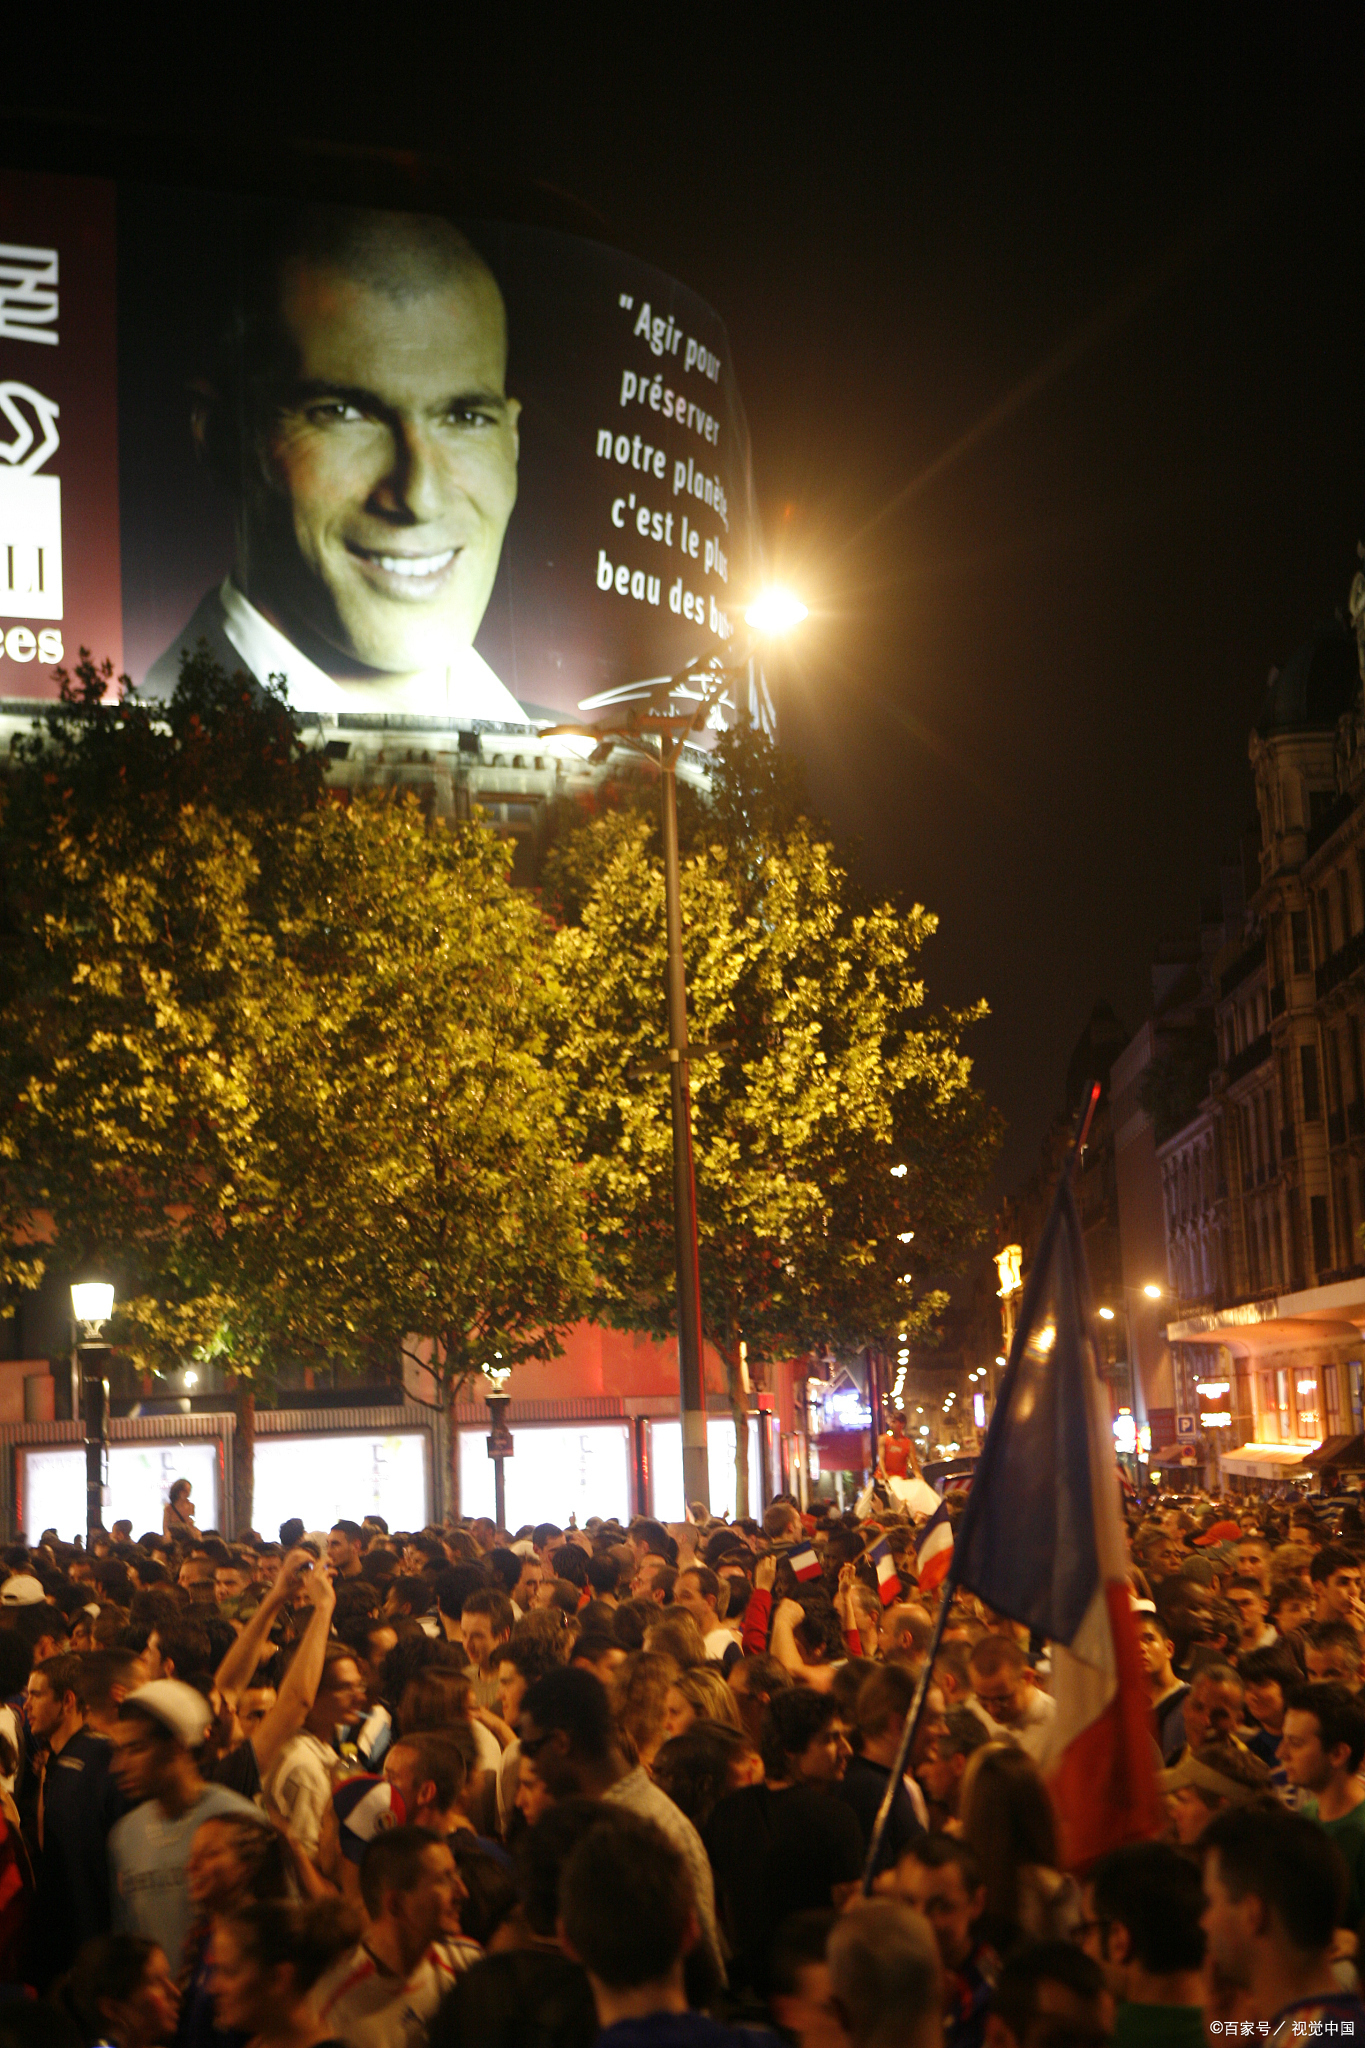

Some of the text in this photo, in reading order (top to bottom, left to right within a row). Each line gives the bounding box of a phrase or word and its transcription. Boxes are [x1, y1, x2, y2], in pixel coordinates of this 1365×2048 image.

[684, 337, 721, 384] pour
[620, 369, 719, 446] préserver
[596, 429, 666, 479] notre
[611, 493, 674, 546] c'est
[680, 516, 700, 558] le
[596, 550, 661, 606] beau
[669, 577, 705, 625] des
